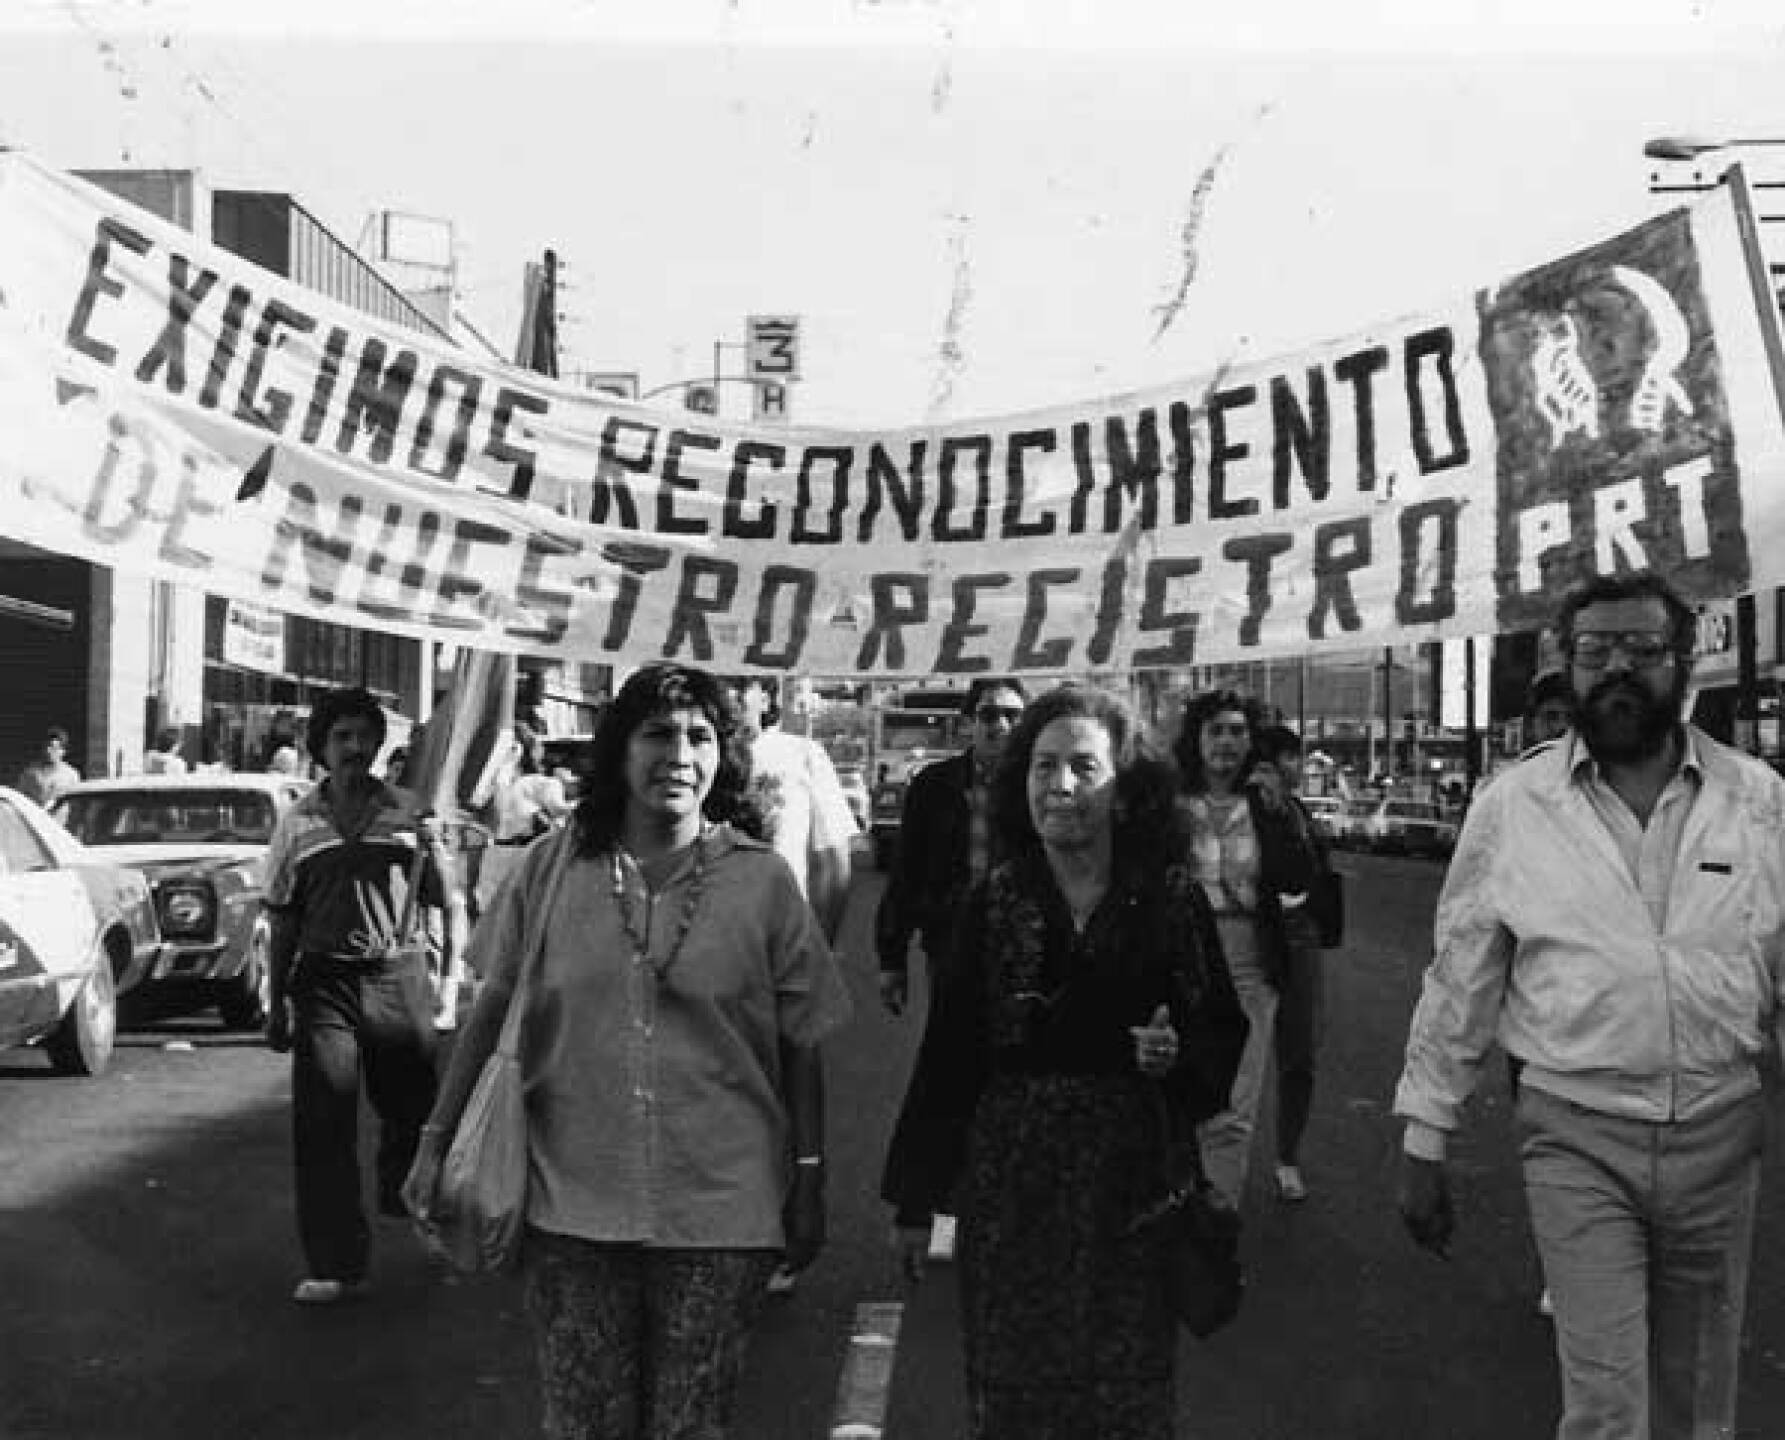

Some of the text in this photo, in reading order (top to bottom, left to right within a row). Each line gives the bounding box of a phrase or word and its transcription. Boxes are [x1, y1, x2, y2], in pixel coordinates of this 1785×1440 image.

[66, 215, 1470, 545] EXIGIMOS RECONOCIMIENTO
[82, 412, 216, 569] DE
[260, 480, 817, 671] NUESTRO
[1517, 457, 1713, 594] PRT
